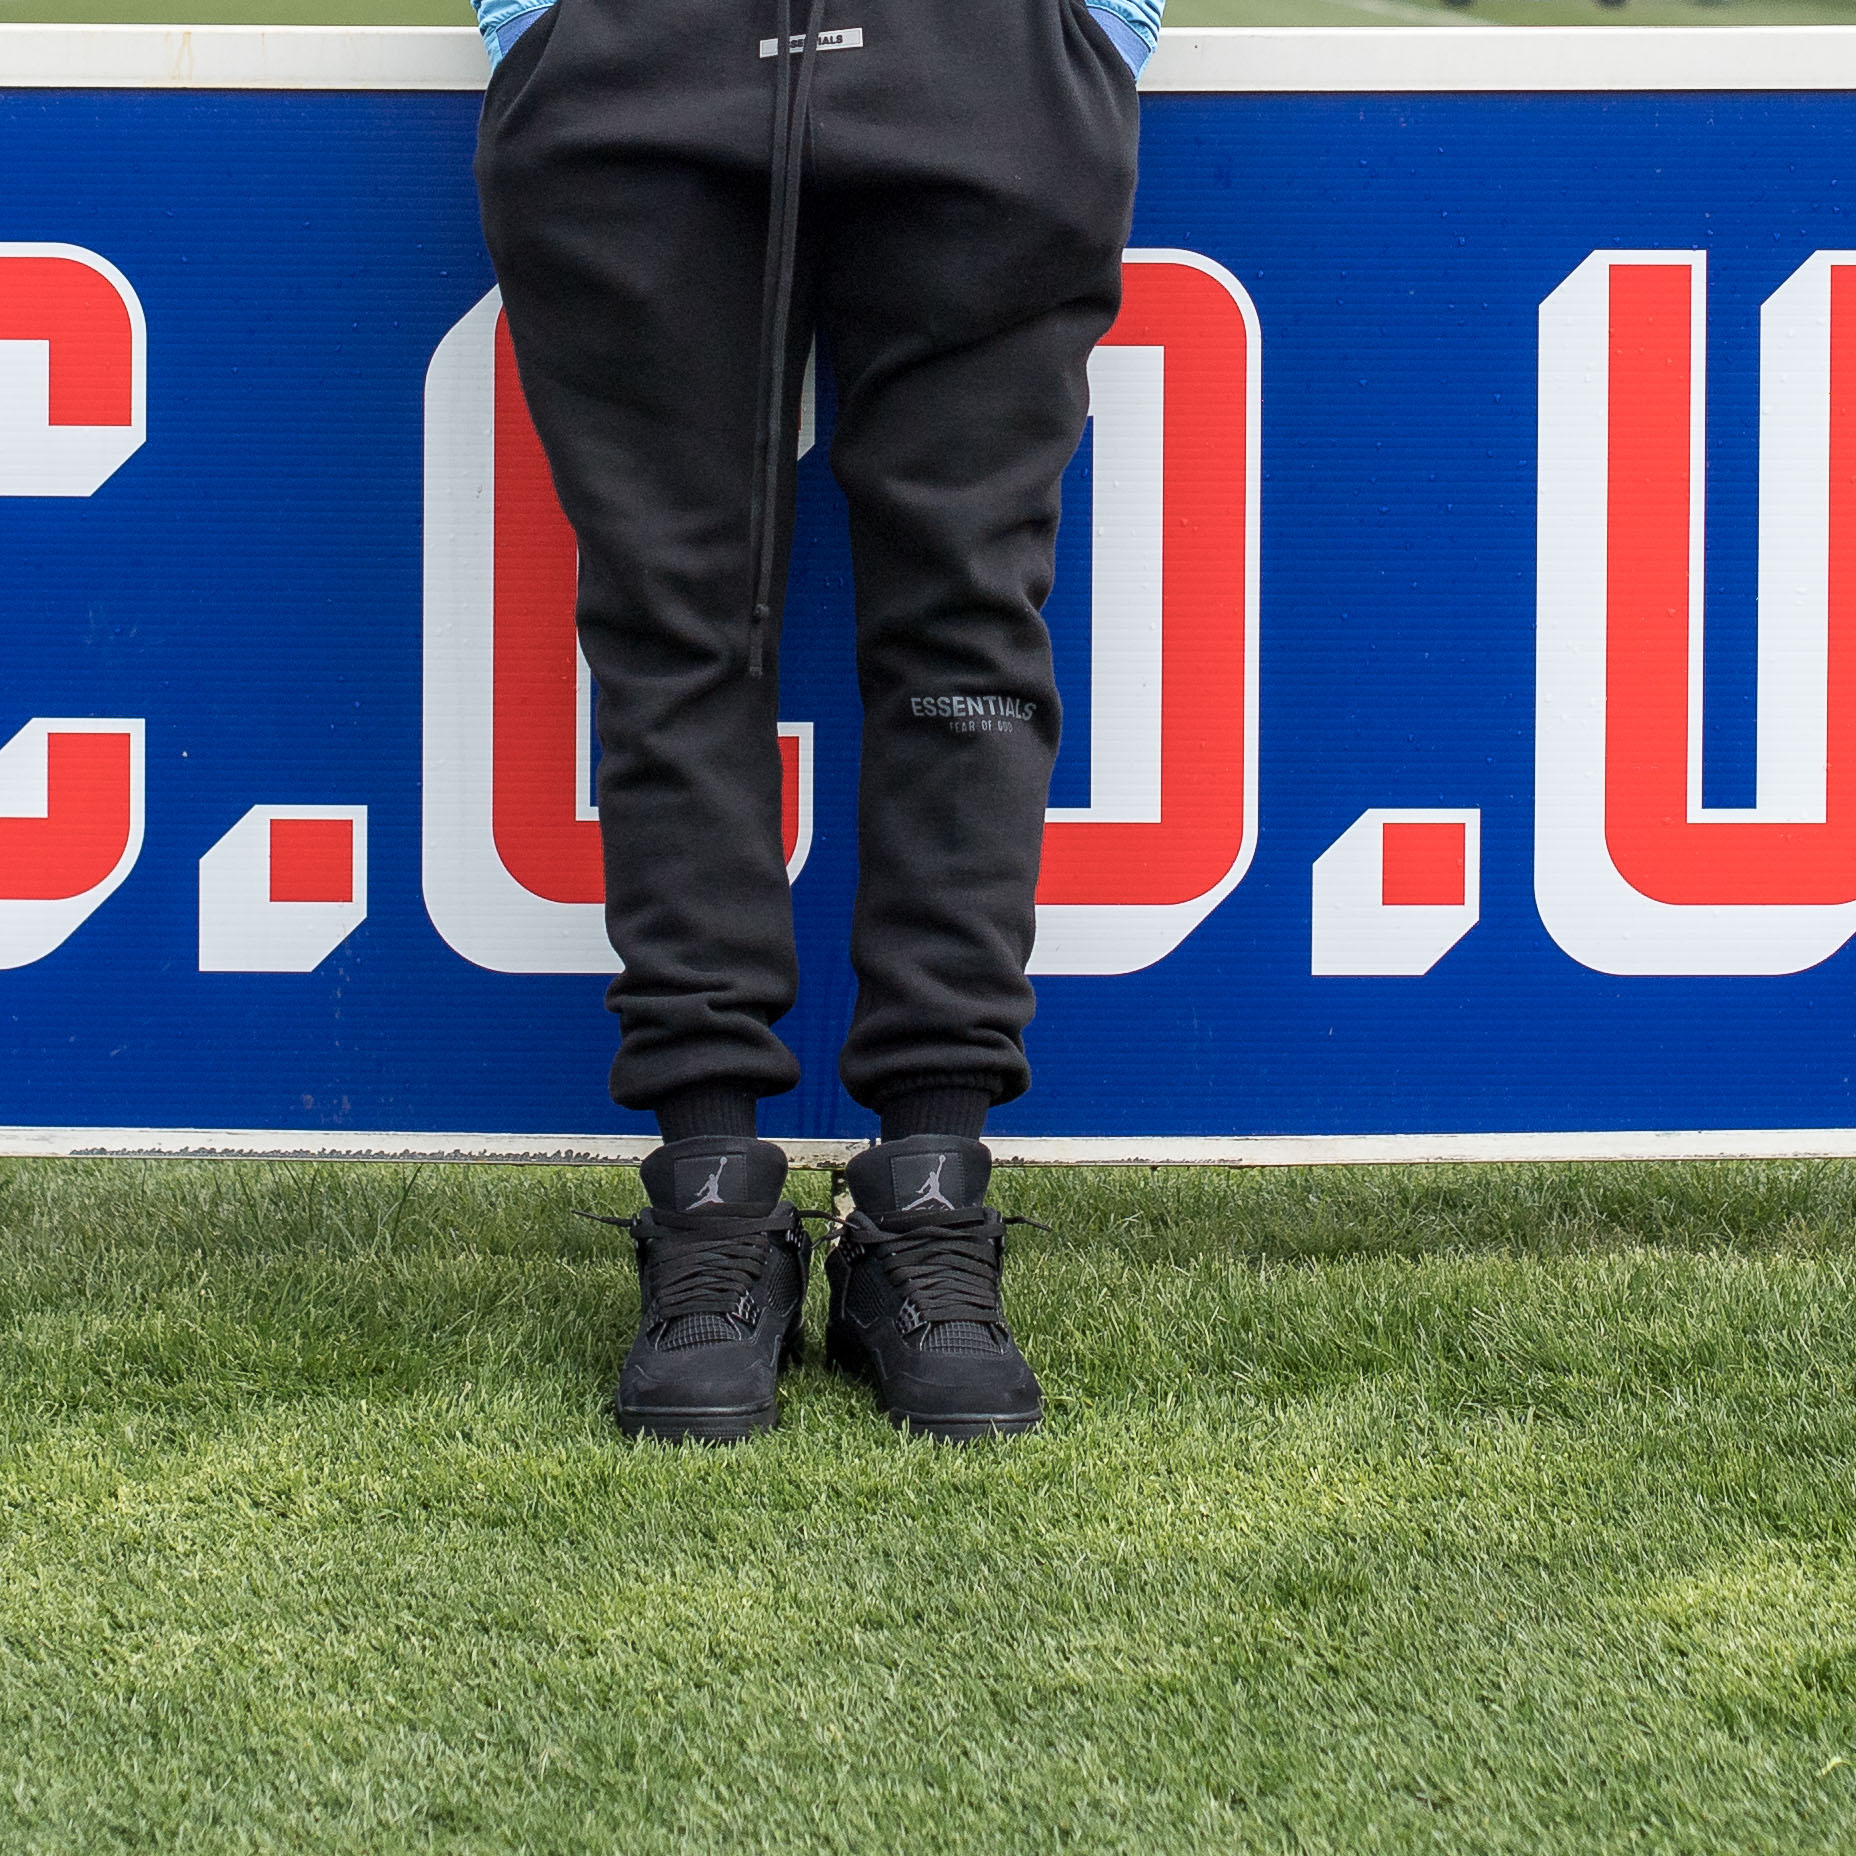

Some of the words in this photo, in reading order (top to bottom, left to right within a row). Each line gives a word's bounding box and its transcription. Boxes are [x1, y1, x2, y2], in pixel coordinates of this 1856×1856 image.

[910, 696, 1037, 721] ESSENTIALS
[949, 720, 976, 733] FEAR
[981, 719, 992, 732] OF
